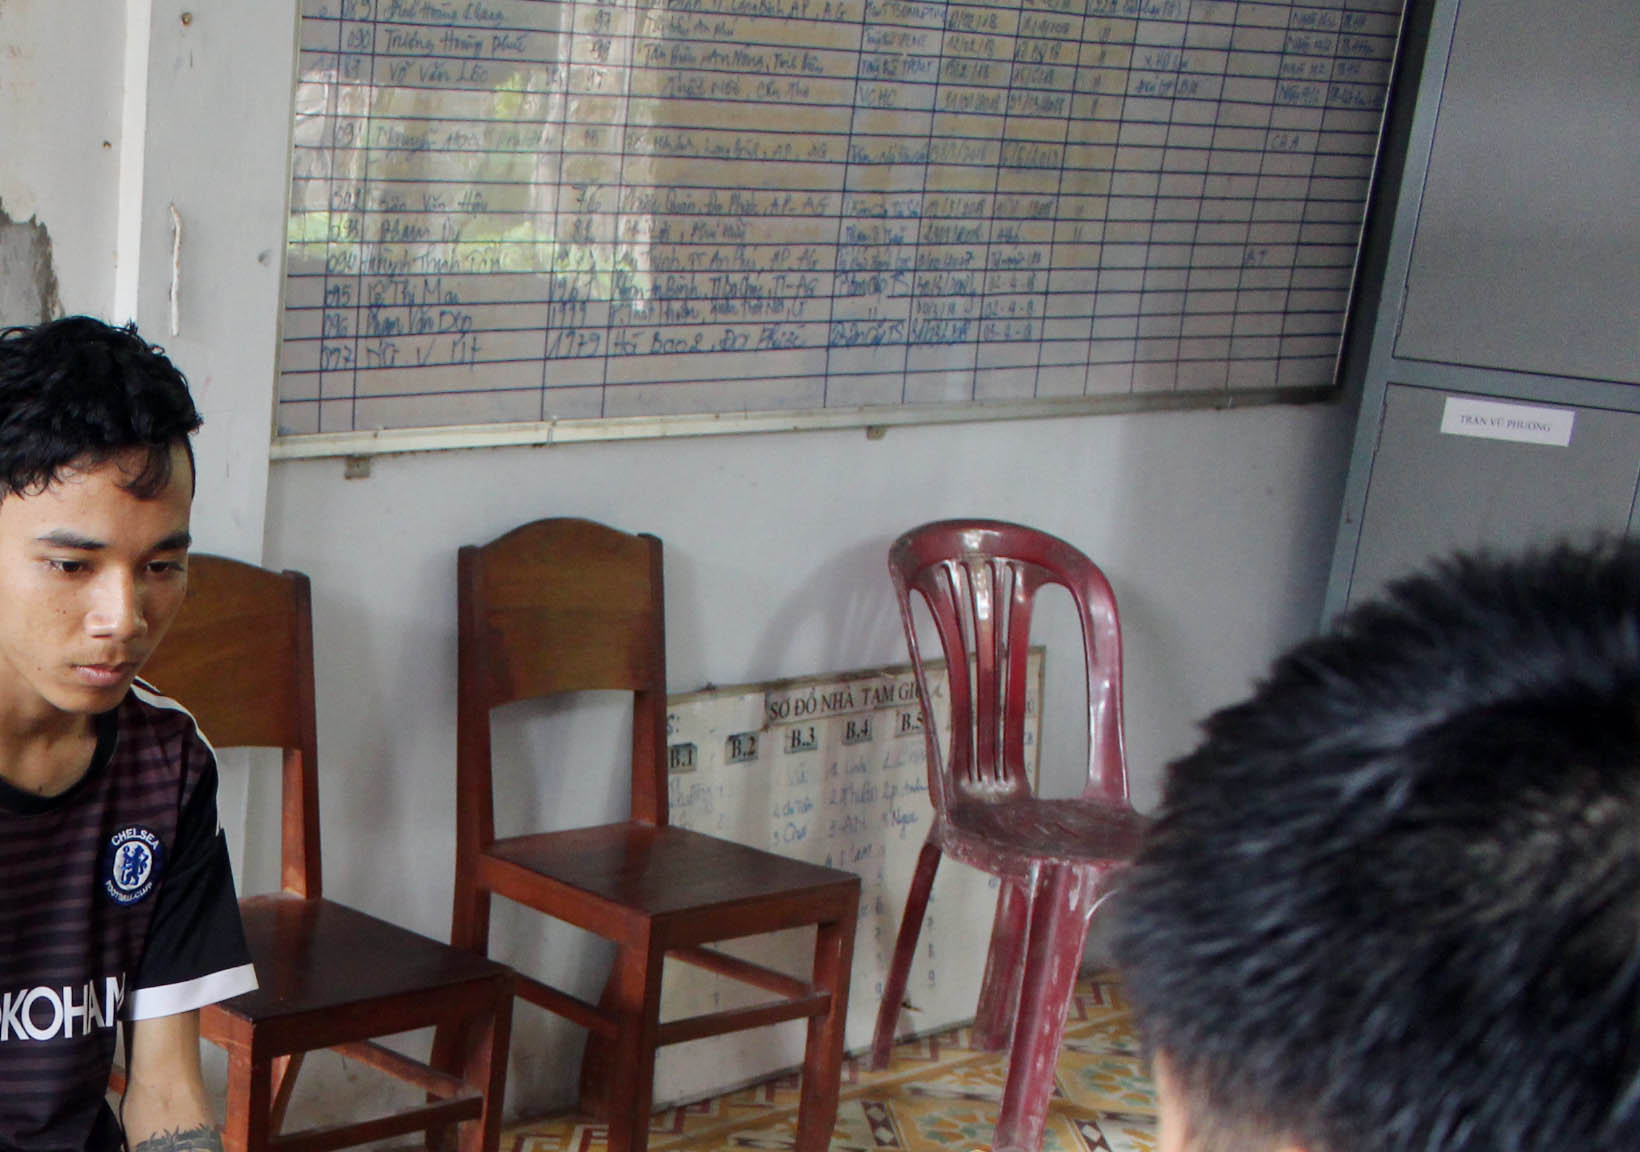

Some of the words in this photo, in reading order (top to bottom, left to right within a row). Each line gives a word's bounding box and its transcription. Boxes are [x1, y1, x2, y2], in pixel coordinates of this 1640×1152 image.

[790, 726, 815, 749] B.3
[845, 719, 869, 741] B.4
[669, 748, 694, 769] B.1
[730, 736, 757, 759] B.2
[111, 827, 159, 850] CHELSEA
